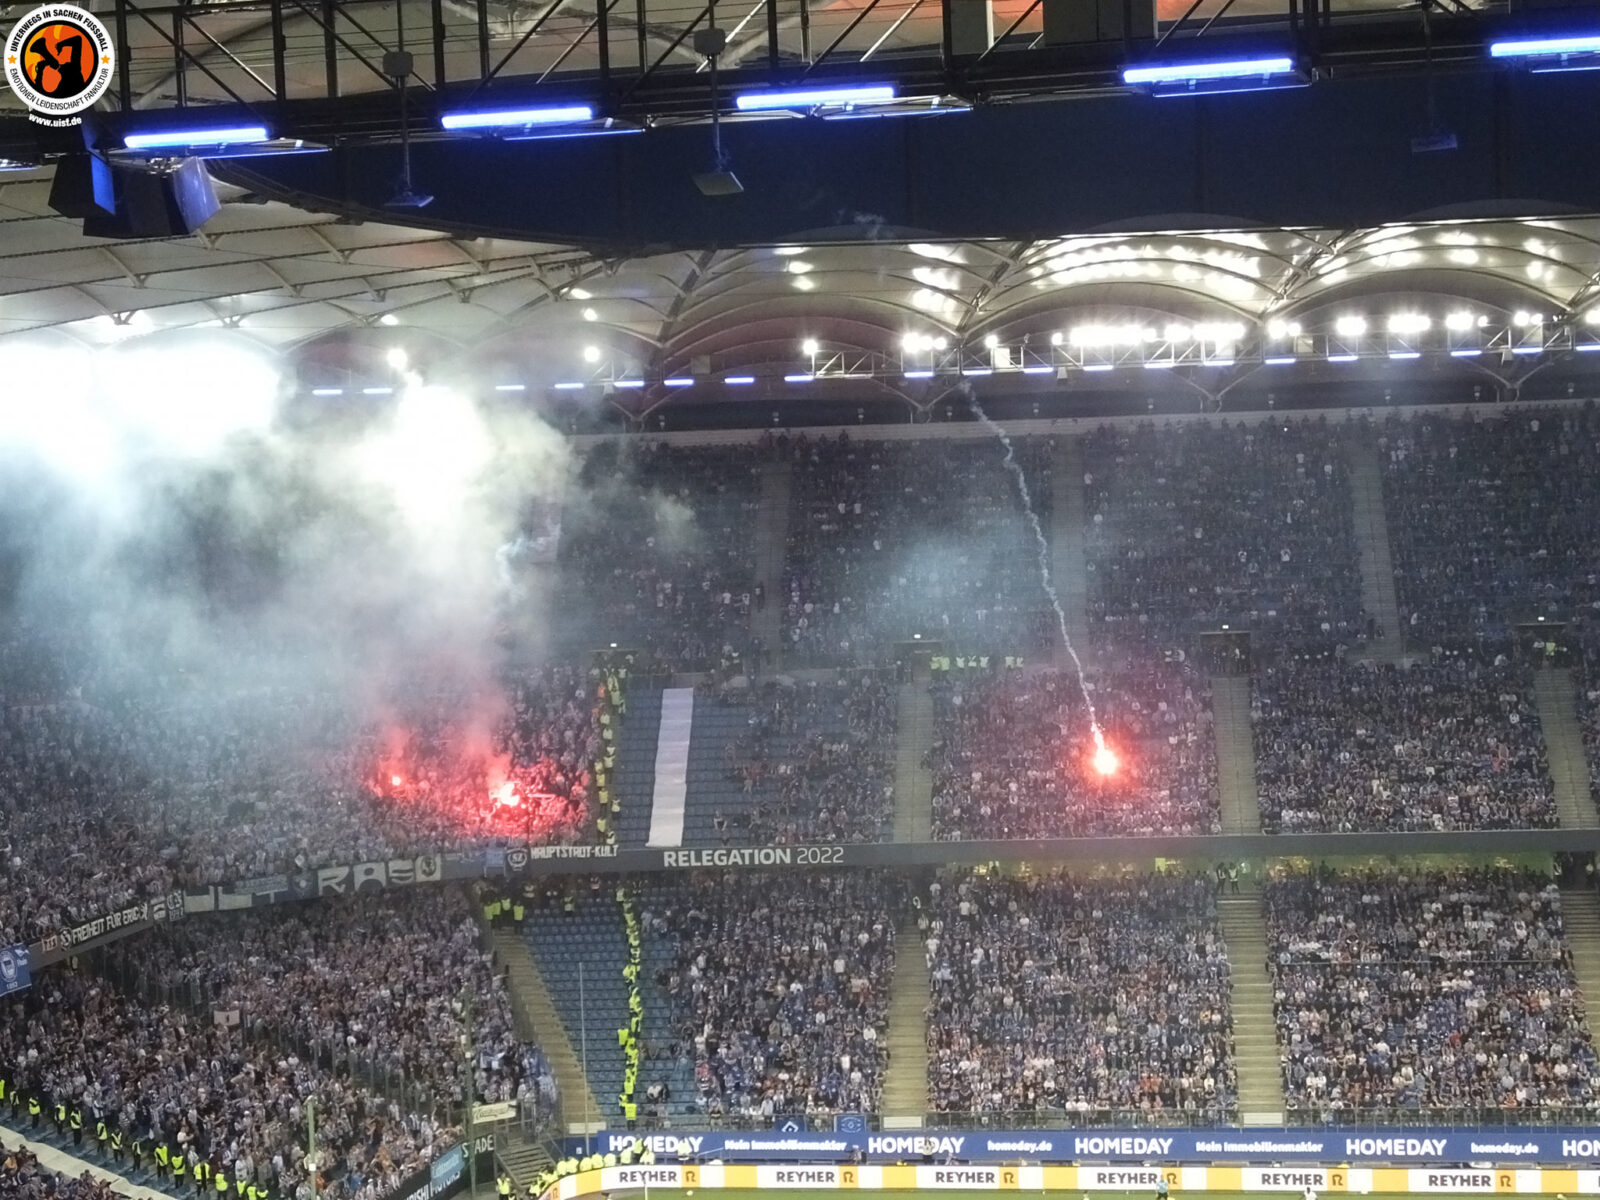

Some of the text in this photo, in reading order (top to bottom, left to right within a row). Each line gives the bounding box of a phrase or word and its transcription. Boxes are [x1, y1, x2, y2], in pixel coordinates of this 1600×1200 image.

[663, 847, 844, 867] RELEGATION 2022
[462, 1134, 494, 1158] SADE
[868, 1138, 965, 1155] HOMEDAY
[1074, 1137, 1173, 1155] HOMEDAY
[1346, 1138, 1447, 1156] HOMEDAY
[1470, 1142, 1539, 1156] homeday.de
[619, 1170, 677, 1183] REYHER
[776, 1171, 835, 1183] REYHER
[935, 1171, 995, 1184] REYHER
[1097, 1172, 1158, 1185] REYHER
[1261, 1173, 1323, 1186] REYHER
[1428, 1174, 1491, 1187] REYHER
